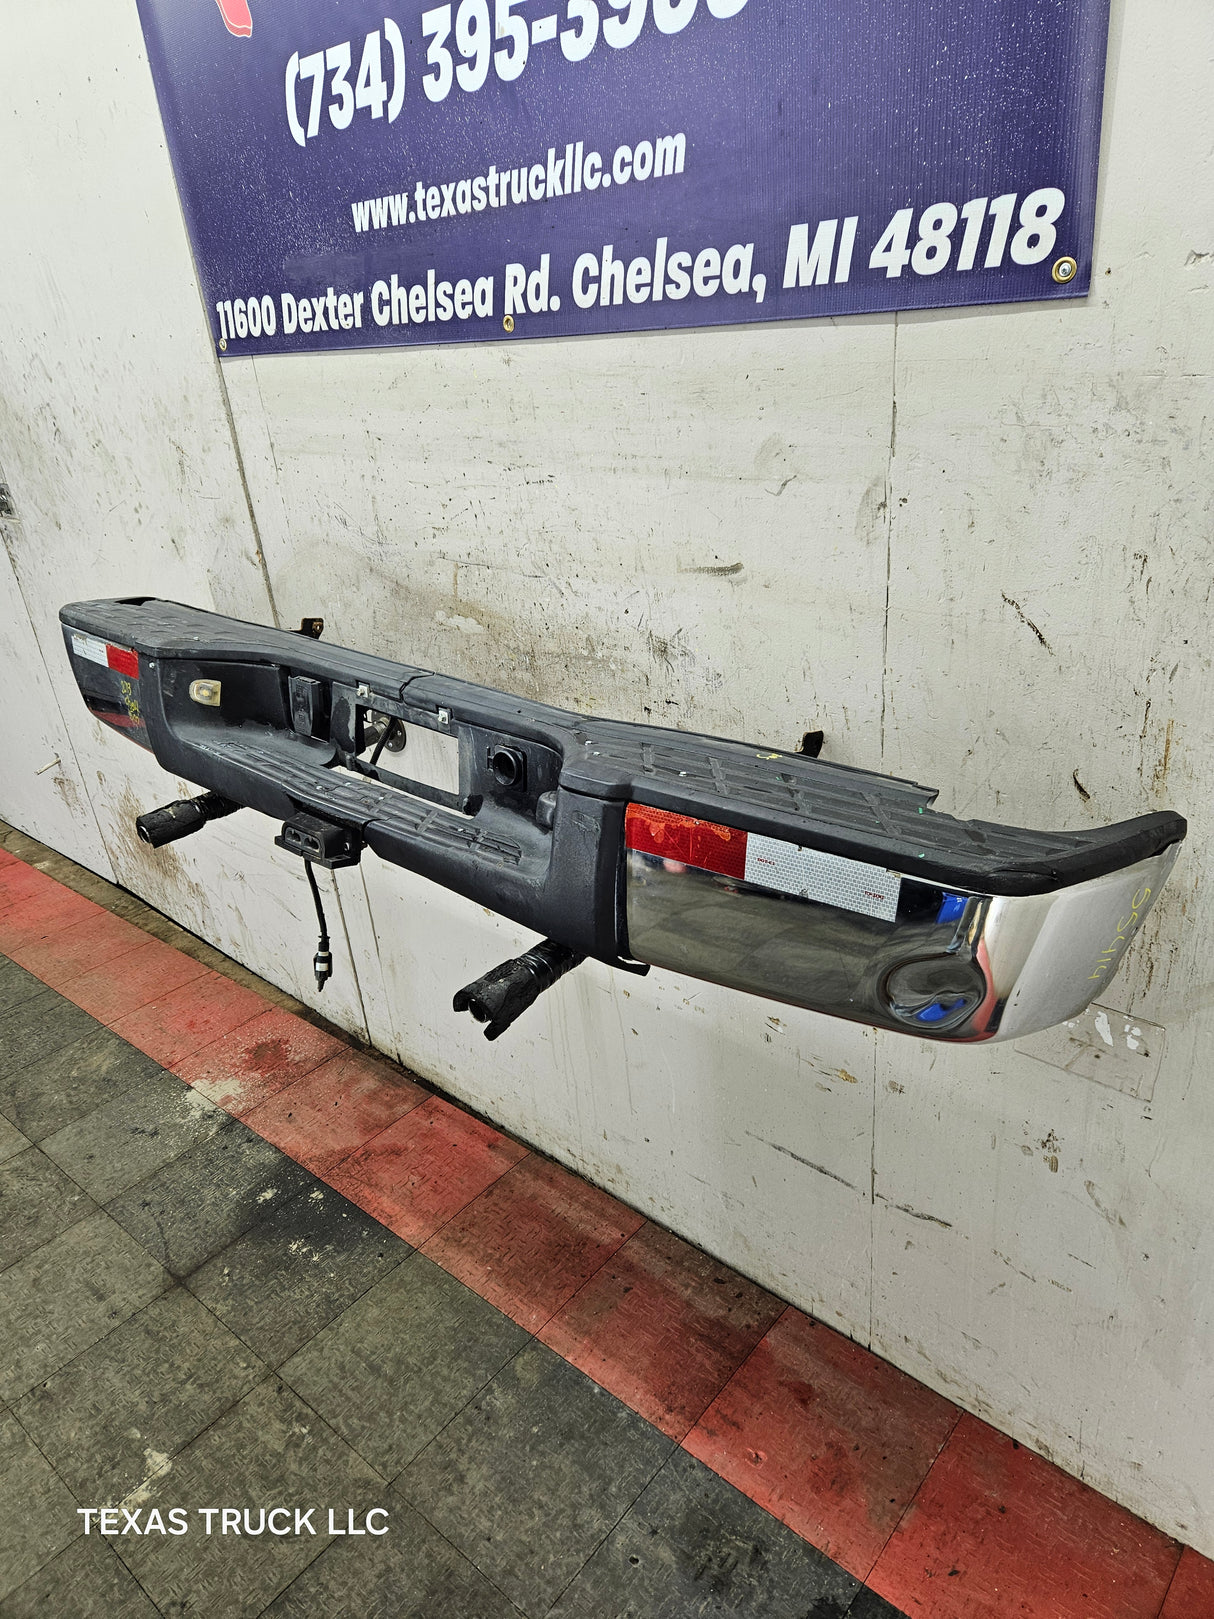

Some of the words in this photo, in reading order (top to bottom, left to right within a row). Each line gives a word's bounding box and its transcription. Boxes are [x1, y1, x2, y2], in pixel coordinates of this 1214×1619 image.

[285, 18, 406, 147] (734)
[421, 0, 749, 103] 395-3
[351, 132, 686, 233] www.texastruckllc.com
[215, 296, 278, 340] 11600
[281, 286, 364, 335] Dexter
[370, 268, 494, 328] Chelsea
[504, 253, 561, 316] Rd.
[572, 236, 768, 312] Chelsea,
[782, 215, 859, 289] MI
[868, 187, 1066, 280] 48118
